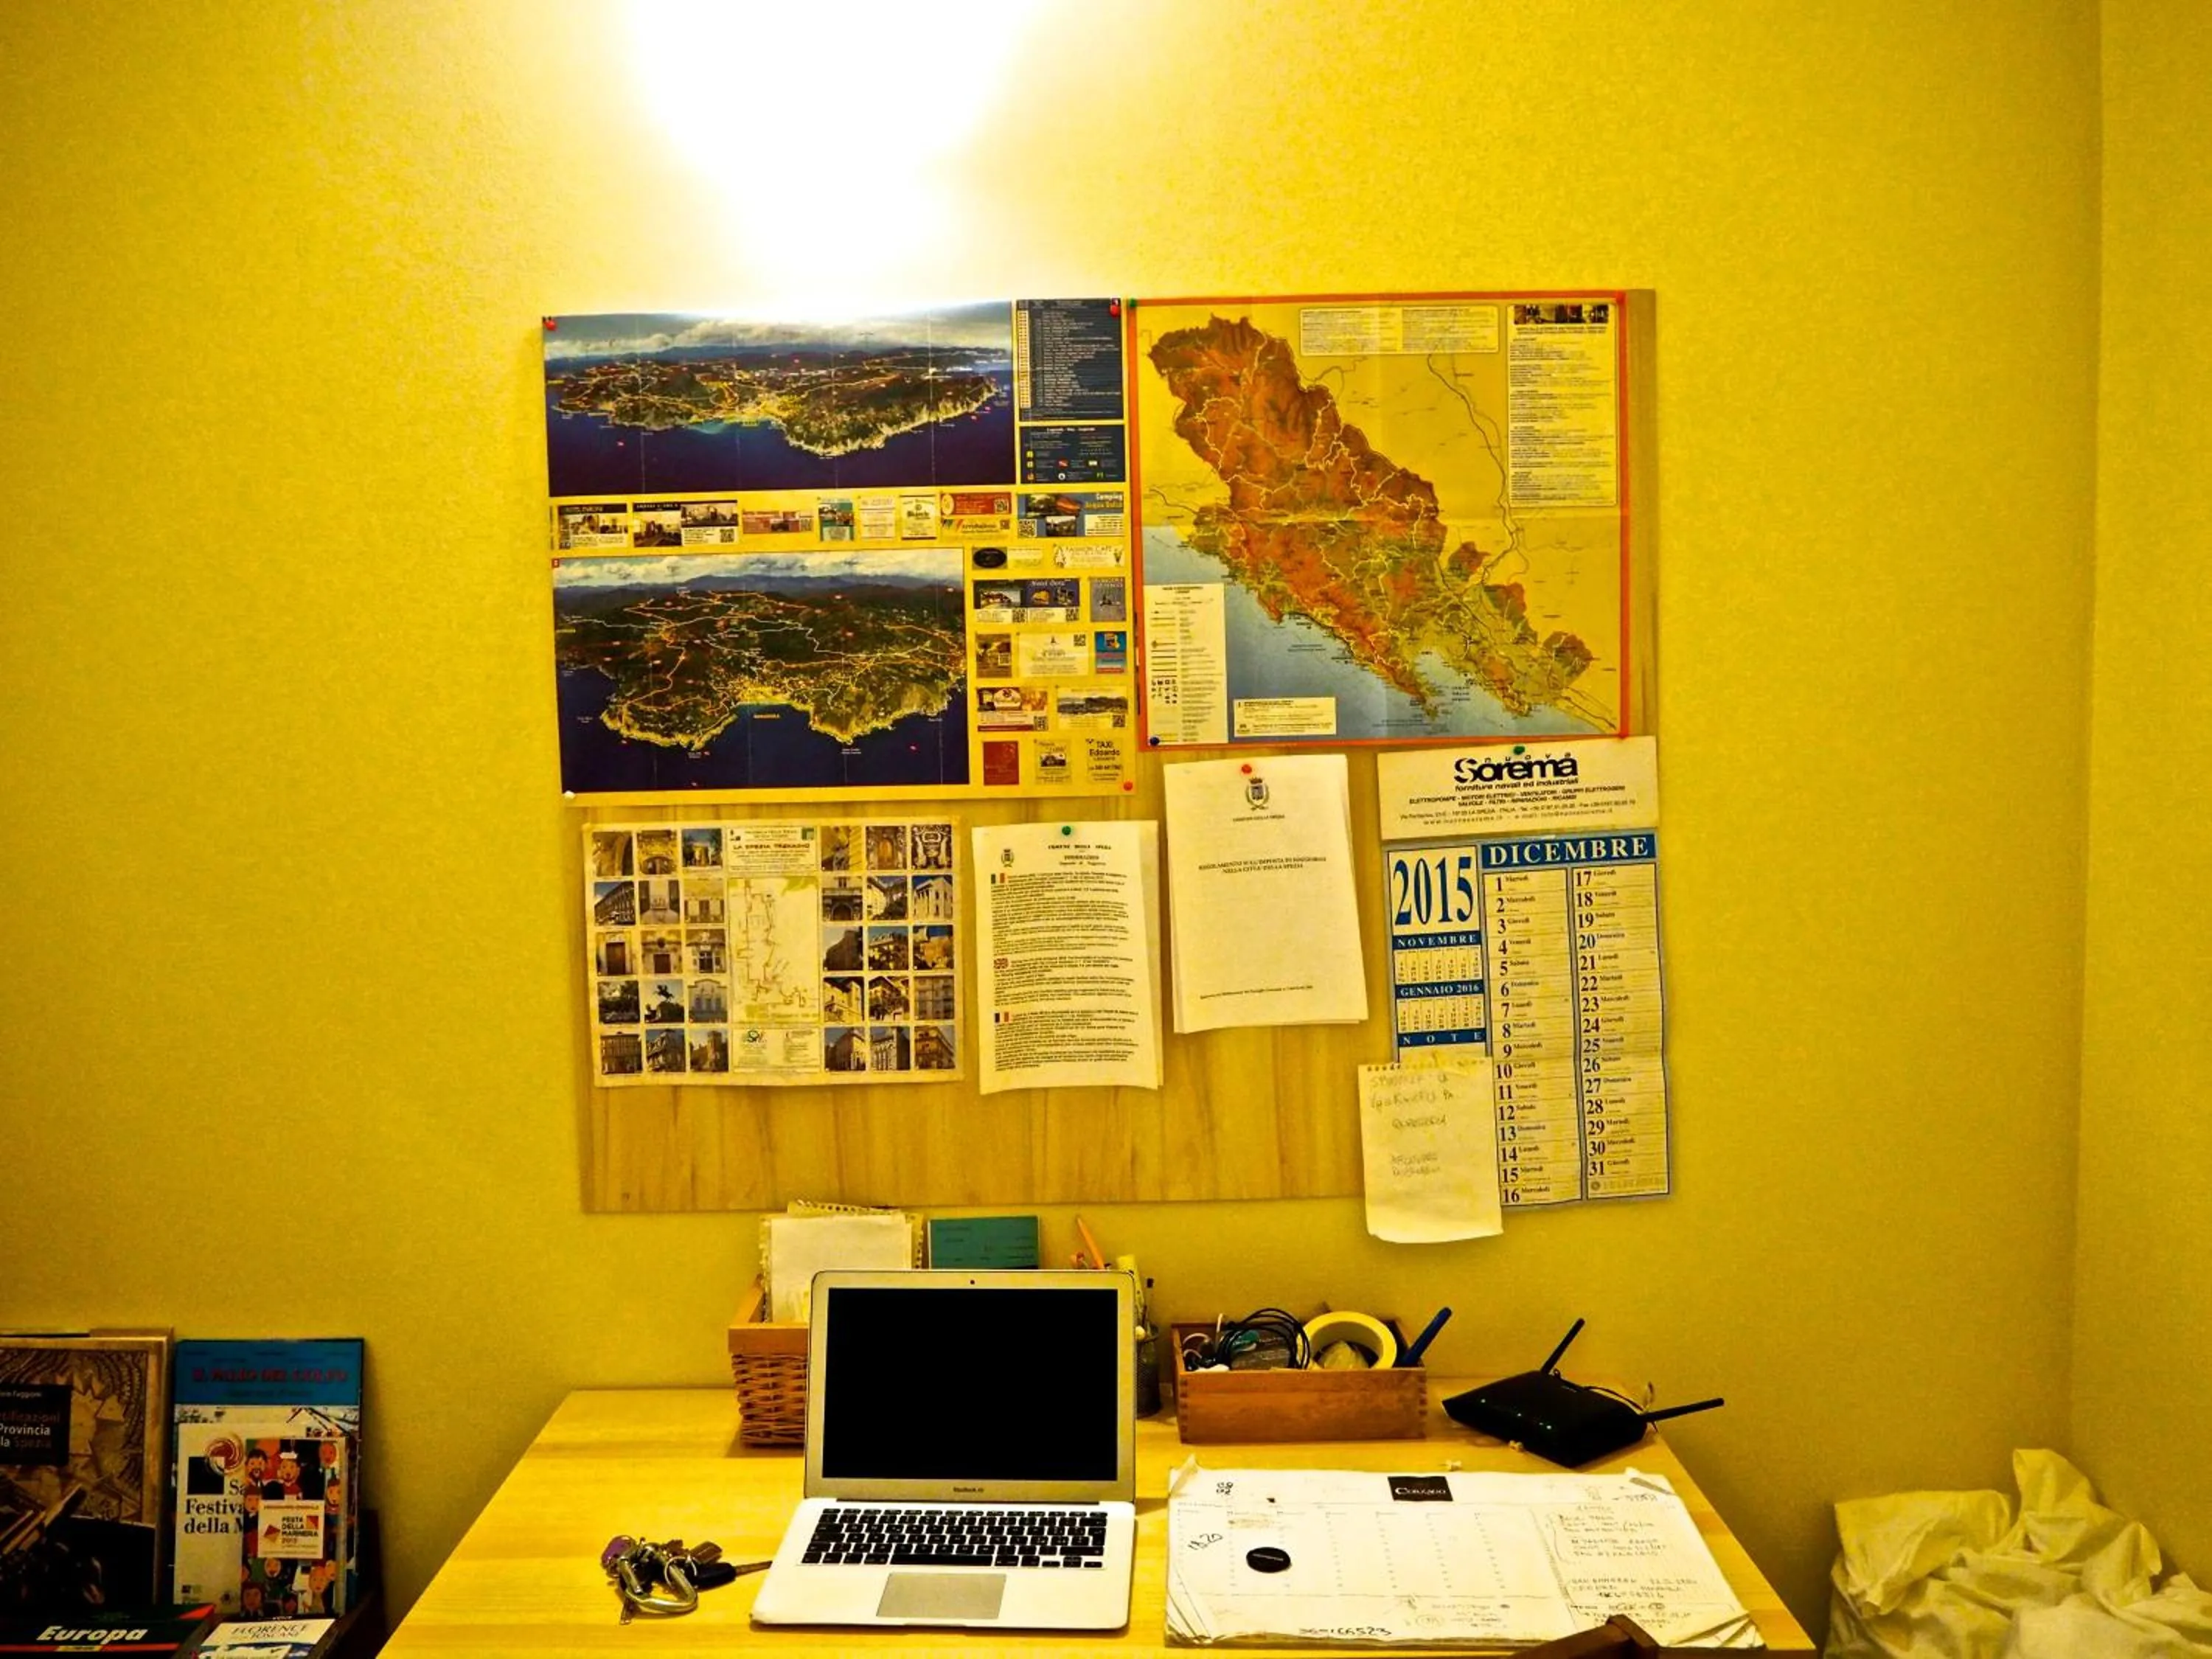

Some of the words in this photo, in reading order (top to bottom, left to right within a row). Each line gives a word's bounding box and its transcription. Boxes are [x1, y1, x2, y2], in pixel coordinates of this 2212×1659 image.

[1455, 783, 1493, 792] forniture
[1495, 782, 1521, 790] navali
[1536, 778, 1579, 787] industriali
[1489, 837, 1648, 866] DICEMBRE
[1496, 877, 1503, 891] 1
[1576, 871, 1591, 886] 17
[1393, 856, 1474, 925] 2015
[1497, 898, 1504, 913] 2
[1576, 892, 1593, 908] 18
[1498, 919, 1506, 933] 3
[1578, 913, 1593, 928] 19
[1398, 935, 1477, 947] NOVEMBRE
[1498, 939, 1507, 955] 4
[1579, 934, 1596, 950] 20
[1500, 961, 1508, 976] 5
[1580, 956, 1596, 970] 21
[1401, 985, 1453, 996] GENNAIO
[1456, 984, 1480, 994] 2016
[1500, 982, 1509, 997] 6
[1581, 976, 1598, 992] 22
[1501, 1003, 1509, 1018] 7
[1582, 996, 1599, 1012] 23
[1503, 1023, 1511, 1038] 8
[1583, 1018, 1600, 1032] 24
[1503, 1044, 1512, 1057] 9
[1583, 1038, 1600, 1053] 25
[1496, 1064, 1512, 1079] 10
[1584, 1058, 1600, 1072] 26
[1498, 1085, 1512, 1100] 11
[1585, 1078, 1601, 1093] 27
[1499, 1105, 1514, 1121] 12
[1586, 1099, 1603, 1114] 28
[1500, 1126, 1516, 1141] 13
[1587, 1120, 1604, 1135] 29
[1501, 1147, 1517, 1162] 14
[1588, 1141, 1605, 1156] 30
[1502, 1167, 1519, 1183] 15
[1590, 1161, 1604, 1176] 31
[1502, 1188, 1520, 1203] 16
[184, 1517, 229, 1534] della
[36, 1626, 147, 1645] Europa
